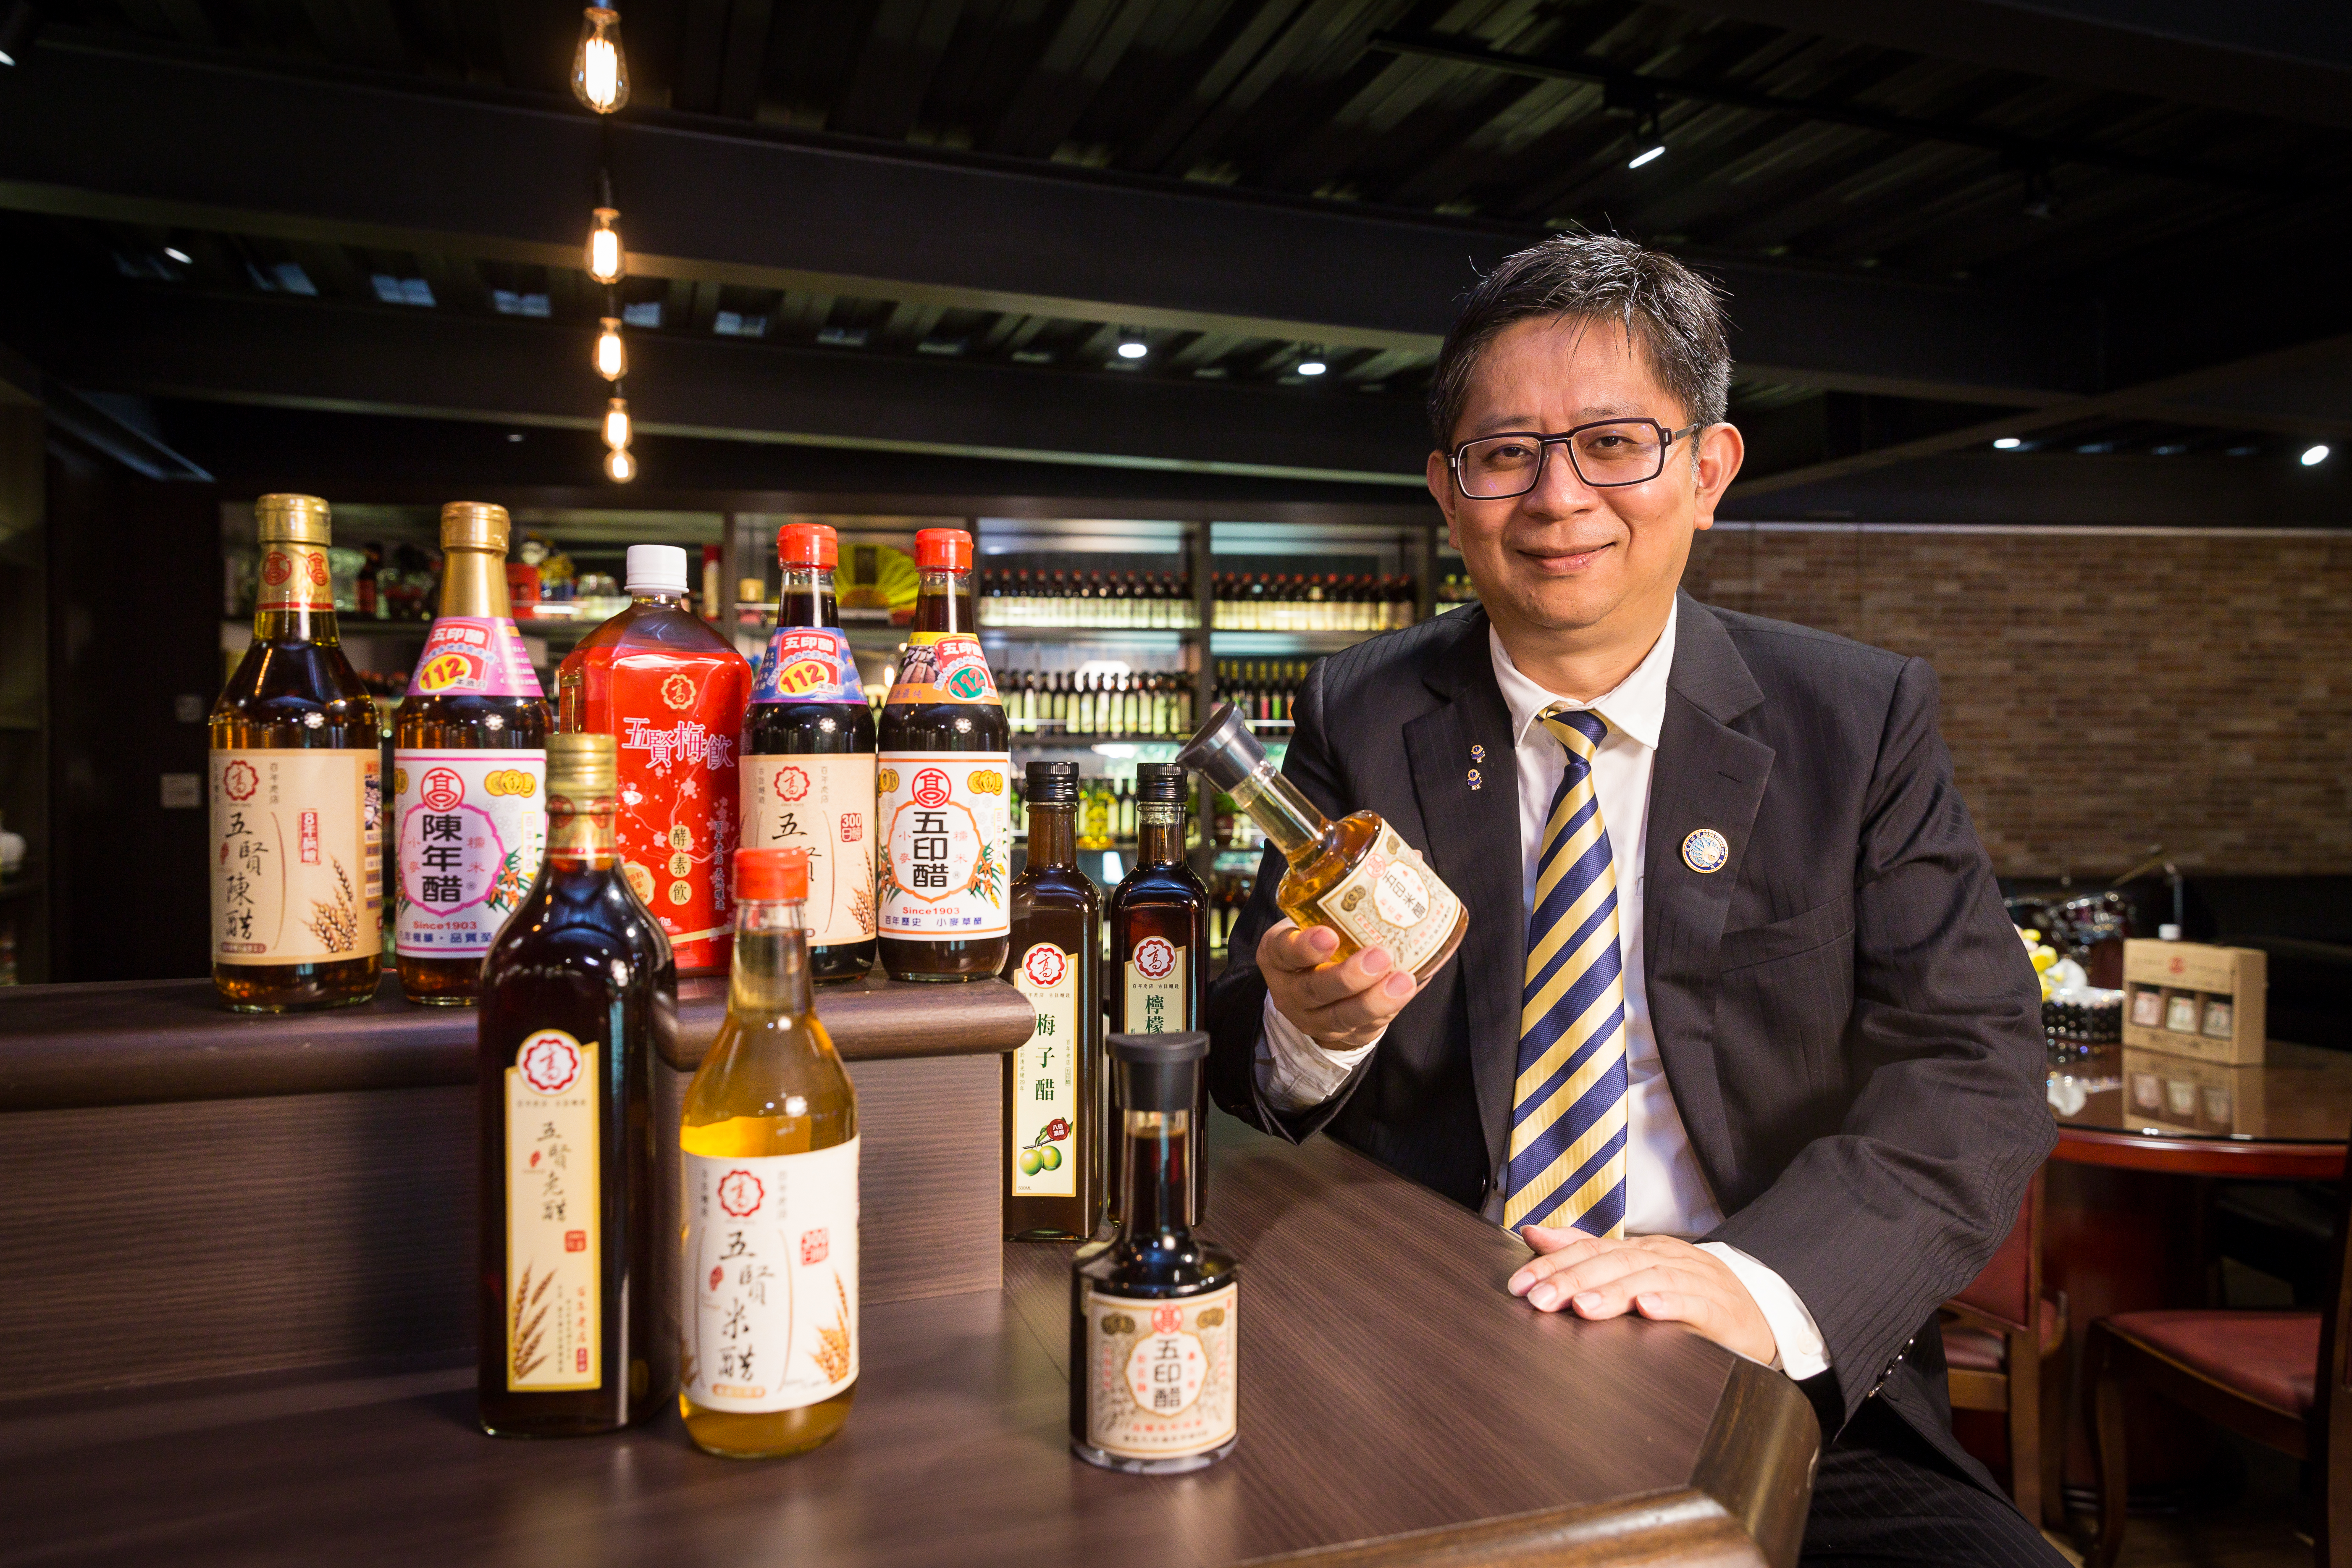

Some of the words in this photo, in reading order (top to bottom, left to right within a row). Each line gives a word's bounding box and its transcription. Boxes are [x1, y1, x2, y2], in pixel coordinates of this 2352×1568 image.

[432, 628, 486, 645] 五印醋
[784, 636, 834, 652] 五印醋
[422, 659, 464, 688] 112
[782, 665, 824, 693] 112
[951, 669, 985, 698] 112
[622, 717, 735, 770] 五賢梅飲
[916, 772, 947, 805] 高
[842, 814, 861, 827] 300
[422, 814, 462, 903] 陳年醋
[899, 831, 911, 864] 小麥
[912, 812, 949, 888] 五印醋
[953, 830, 968, 864] 糯米
[672, 827, 688, 902] 酵素飲
[1383, 871, 1426, 919] 五印米醋
[413, 920, 477, 930] Since1903
[885, 915, 921, 927] 百年歷史
[1037, 953, 1053, 978] 高
[1147, 946, 1162, 970] 高
[1145, 995, 1164, 1035] 檸檬
[1035, 1014, 1055, 1101] 梅子醋
[718, 1230, 775, 1382] 五賢米醋
[1154, 1338, 1181, 1408] 五印醋
